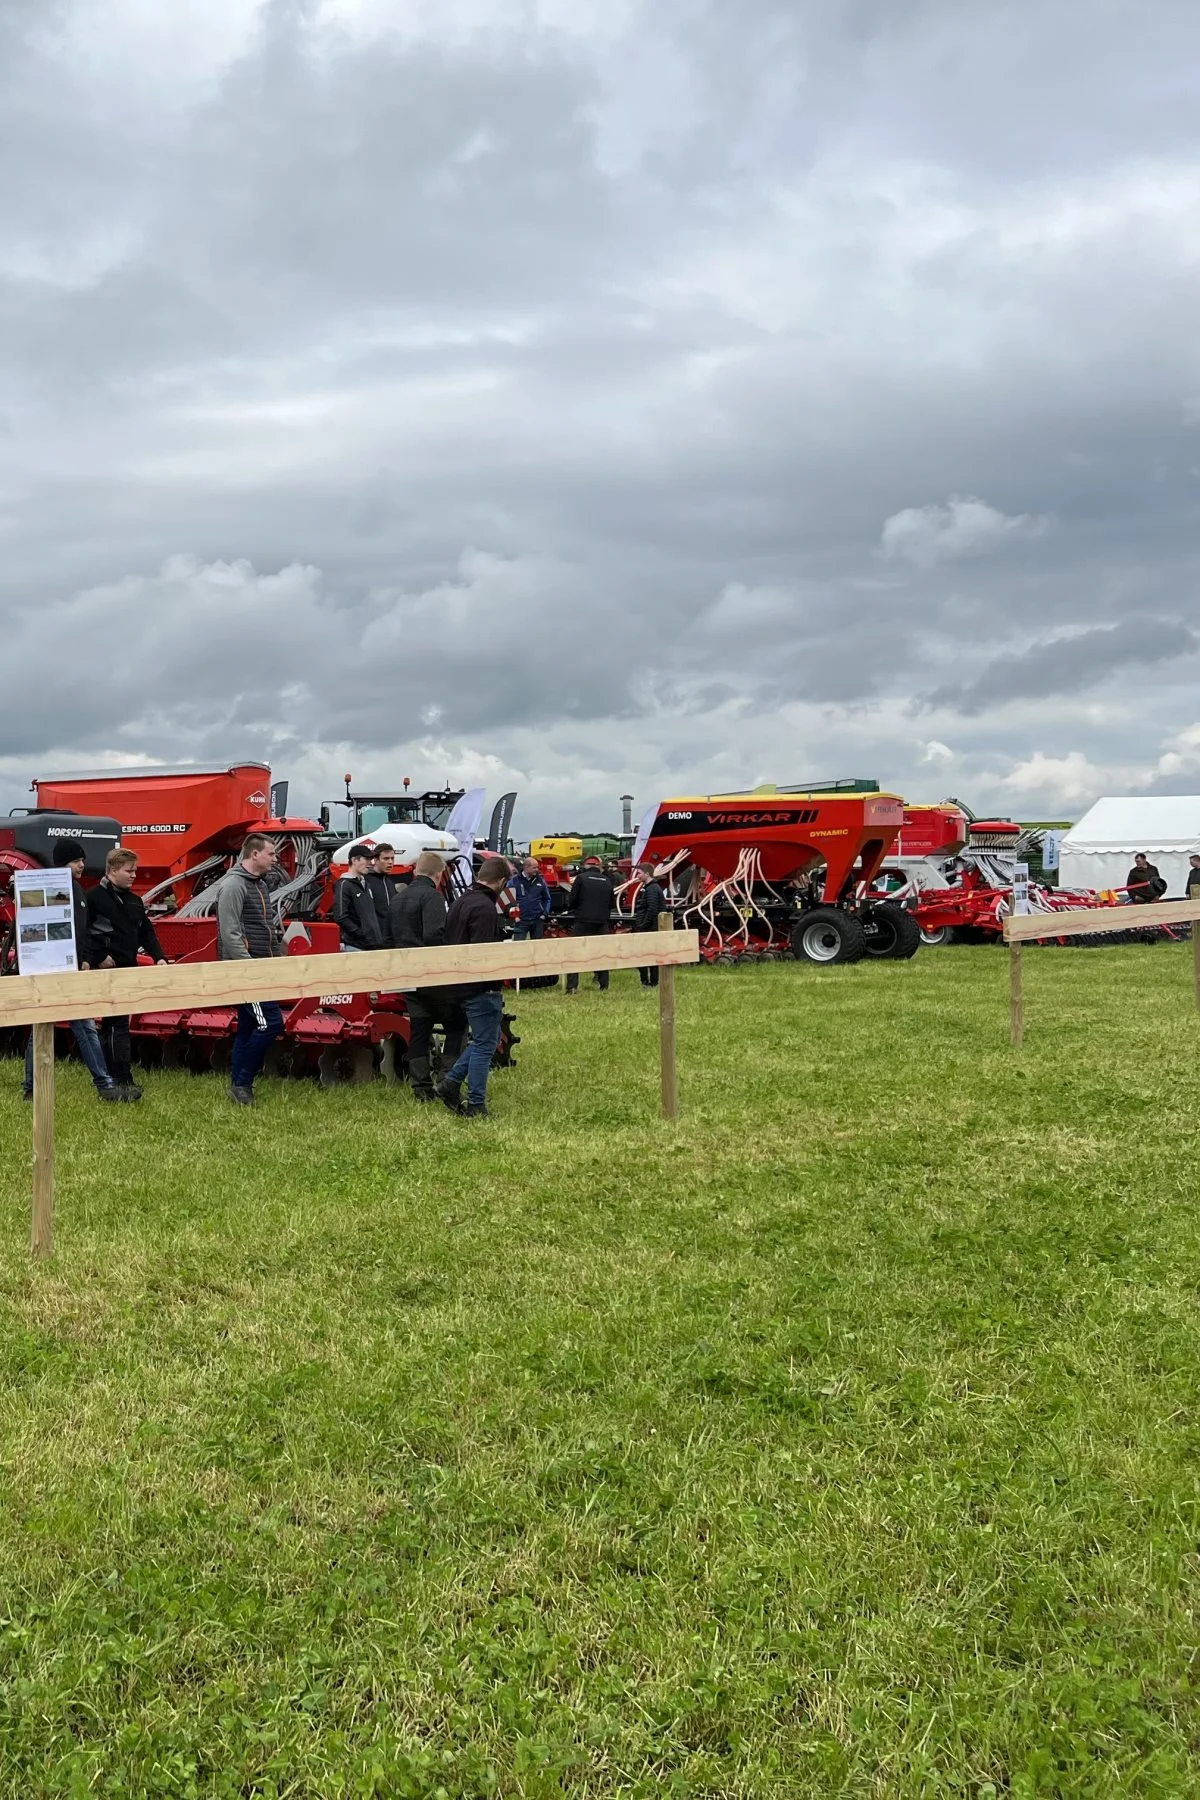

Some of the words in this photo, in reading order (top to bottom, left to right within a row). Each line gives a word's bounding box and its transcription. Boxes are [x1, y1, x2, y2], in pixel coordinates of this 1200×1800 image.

[668, 812, 692, 820] DEMO
[707, 812, 792, 824] VIRKAR
[47, 827, 82, 837] HORSCH
[121, 825, 148, 833] ESPRO
[173, 824, 186, 832] RC
[809, 829, 849, 838] DYNAMIC
[319, 994, 353, 1006] HORSCH
